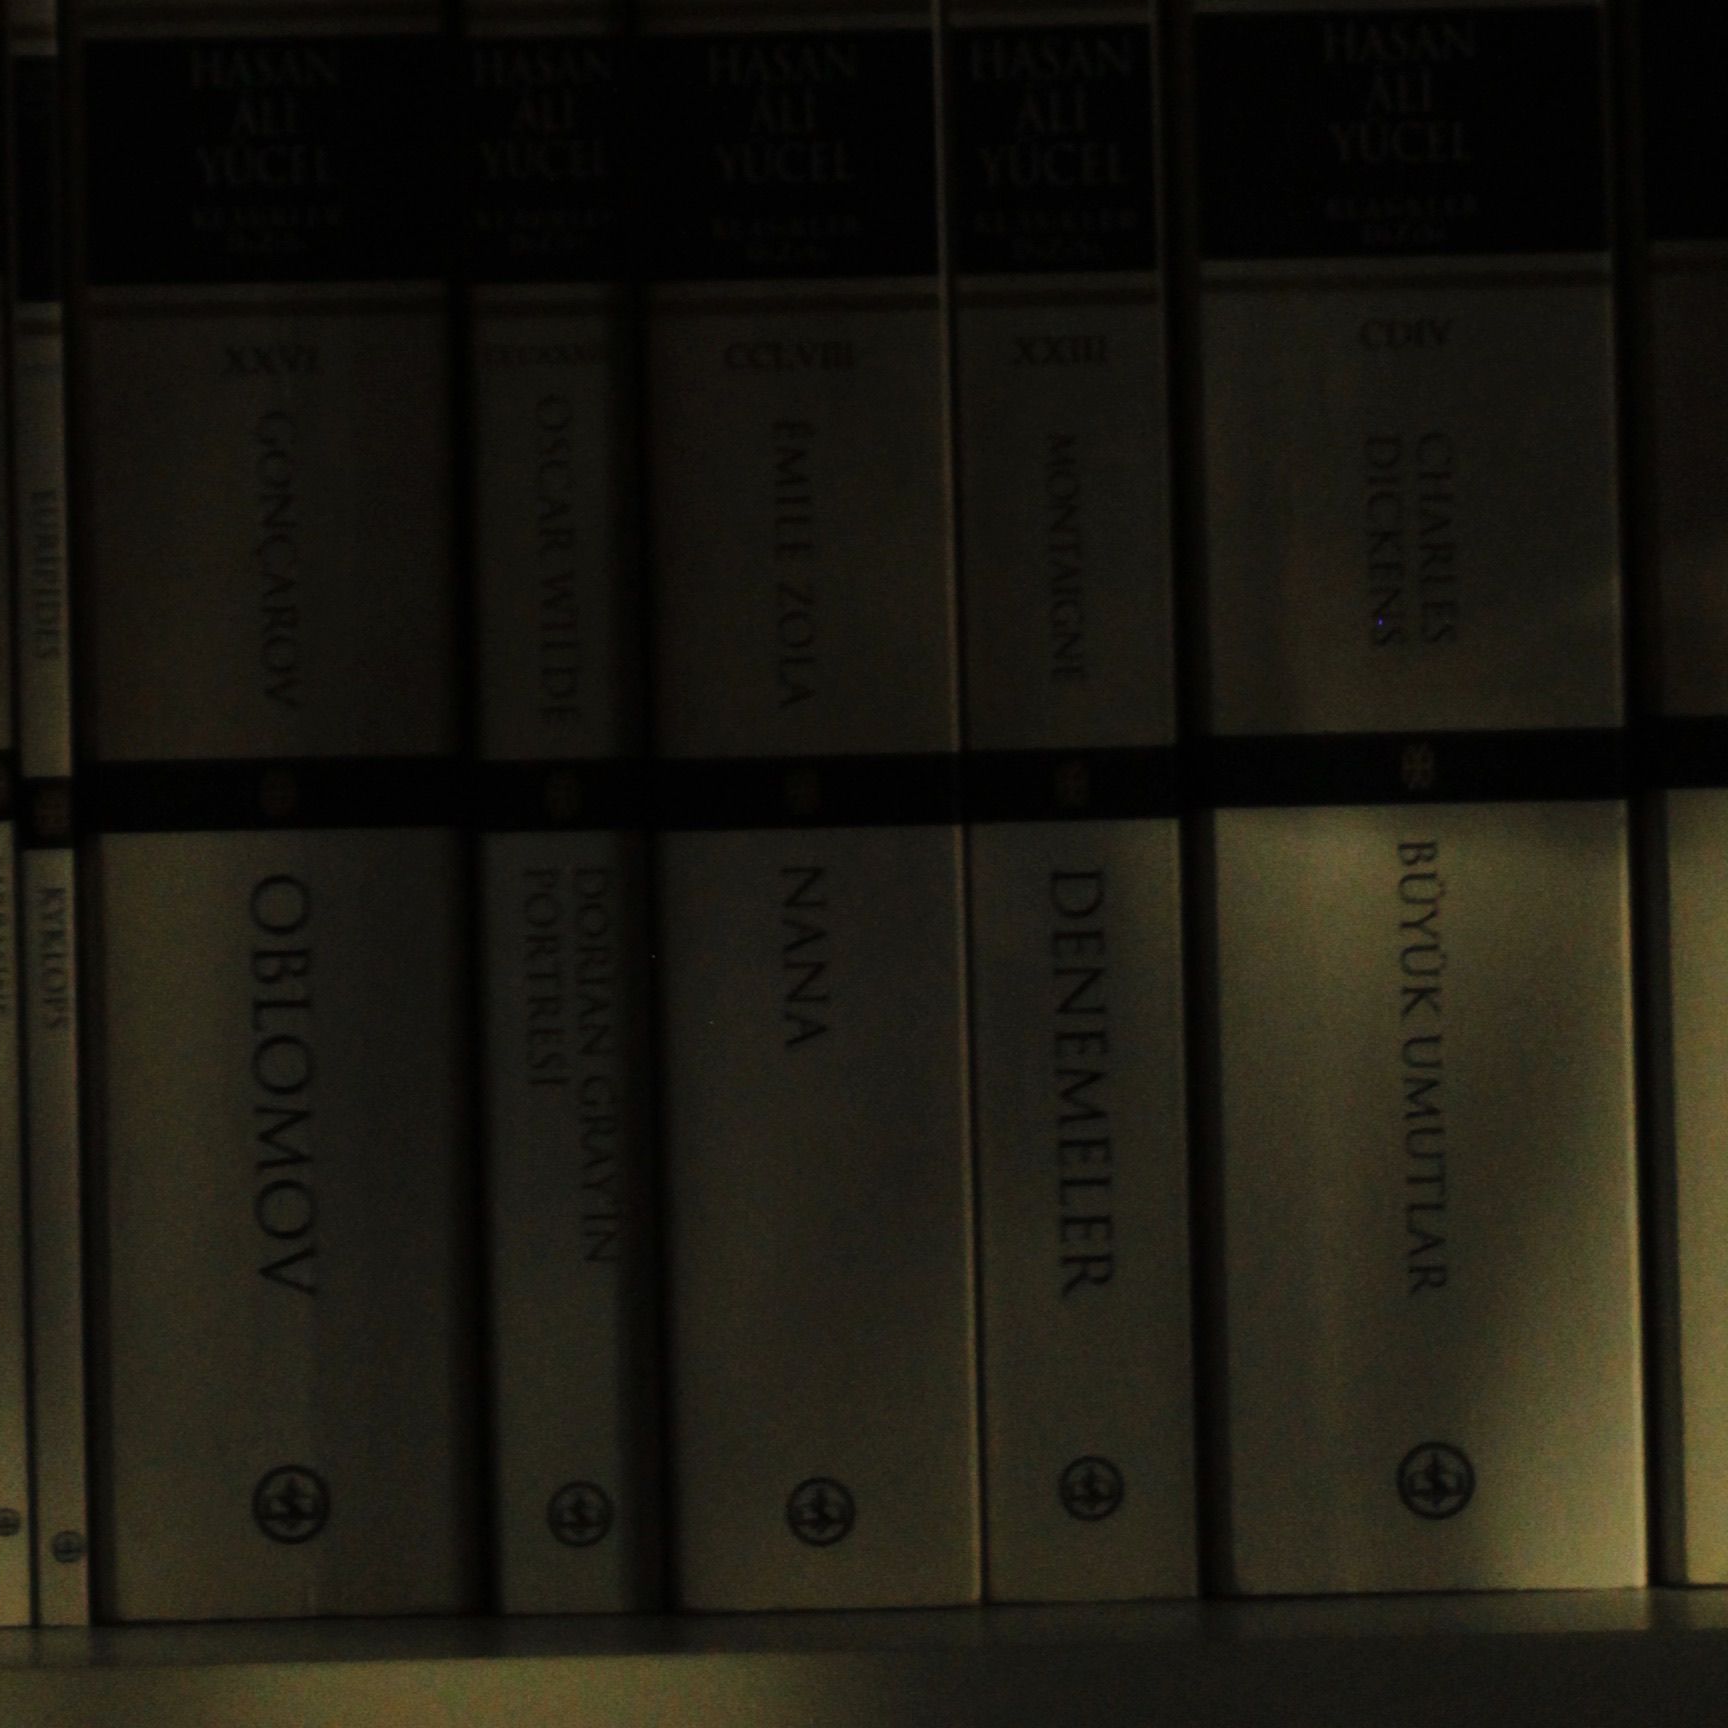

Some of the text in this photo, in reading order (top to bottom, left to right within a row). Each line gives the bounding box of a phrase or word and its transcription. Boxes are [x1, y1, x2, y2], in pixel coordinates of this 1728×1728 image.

[706, 40, 860, 87] HASAN
[968, 39, 1131, 86] HASAN
[1322, 21, 1476, 65] HASAN
[1362, 432, 1405, 650] DICKENS
[1413, 430, 1460, 647] CHARLES
[778, 866, 830, 1051] NANA
[248, 873, 319, 1297] OBLOMOV
[1045, 870, 1115, 1301] DENEMELER
[1394, 840, 1449, 1297] BÜYÜK UMUTLAR
